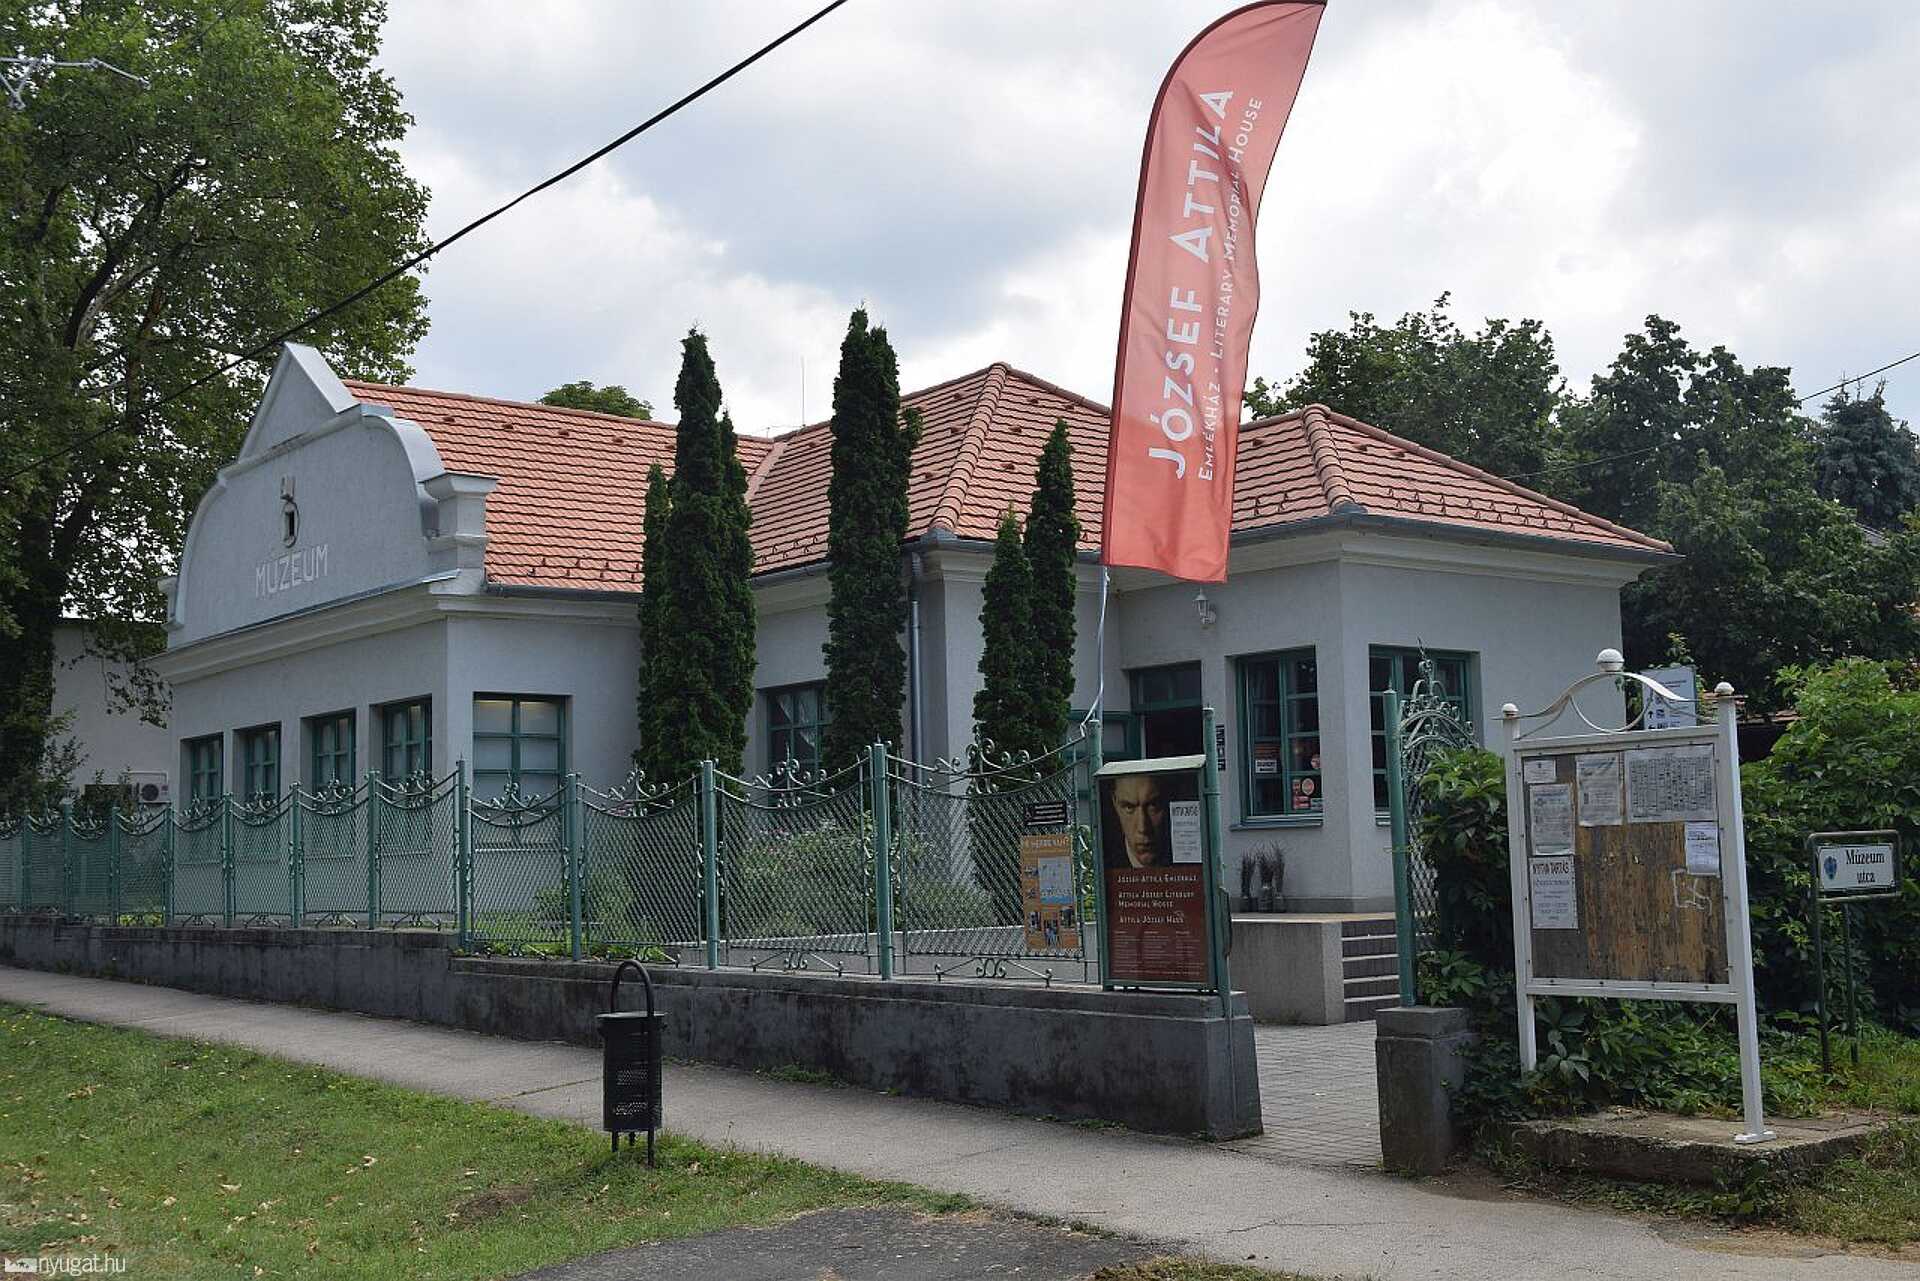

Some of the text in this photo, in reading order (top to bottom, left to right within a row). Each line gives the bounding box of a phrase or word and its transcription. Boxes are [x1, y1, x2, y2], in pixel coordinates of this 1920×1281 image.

[1228, 97, 1262, 164] HOUSE
[1148, 90, 1234, 480] JÓZSEF ATTILA
